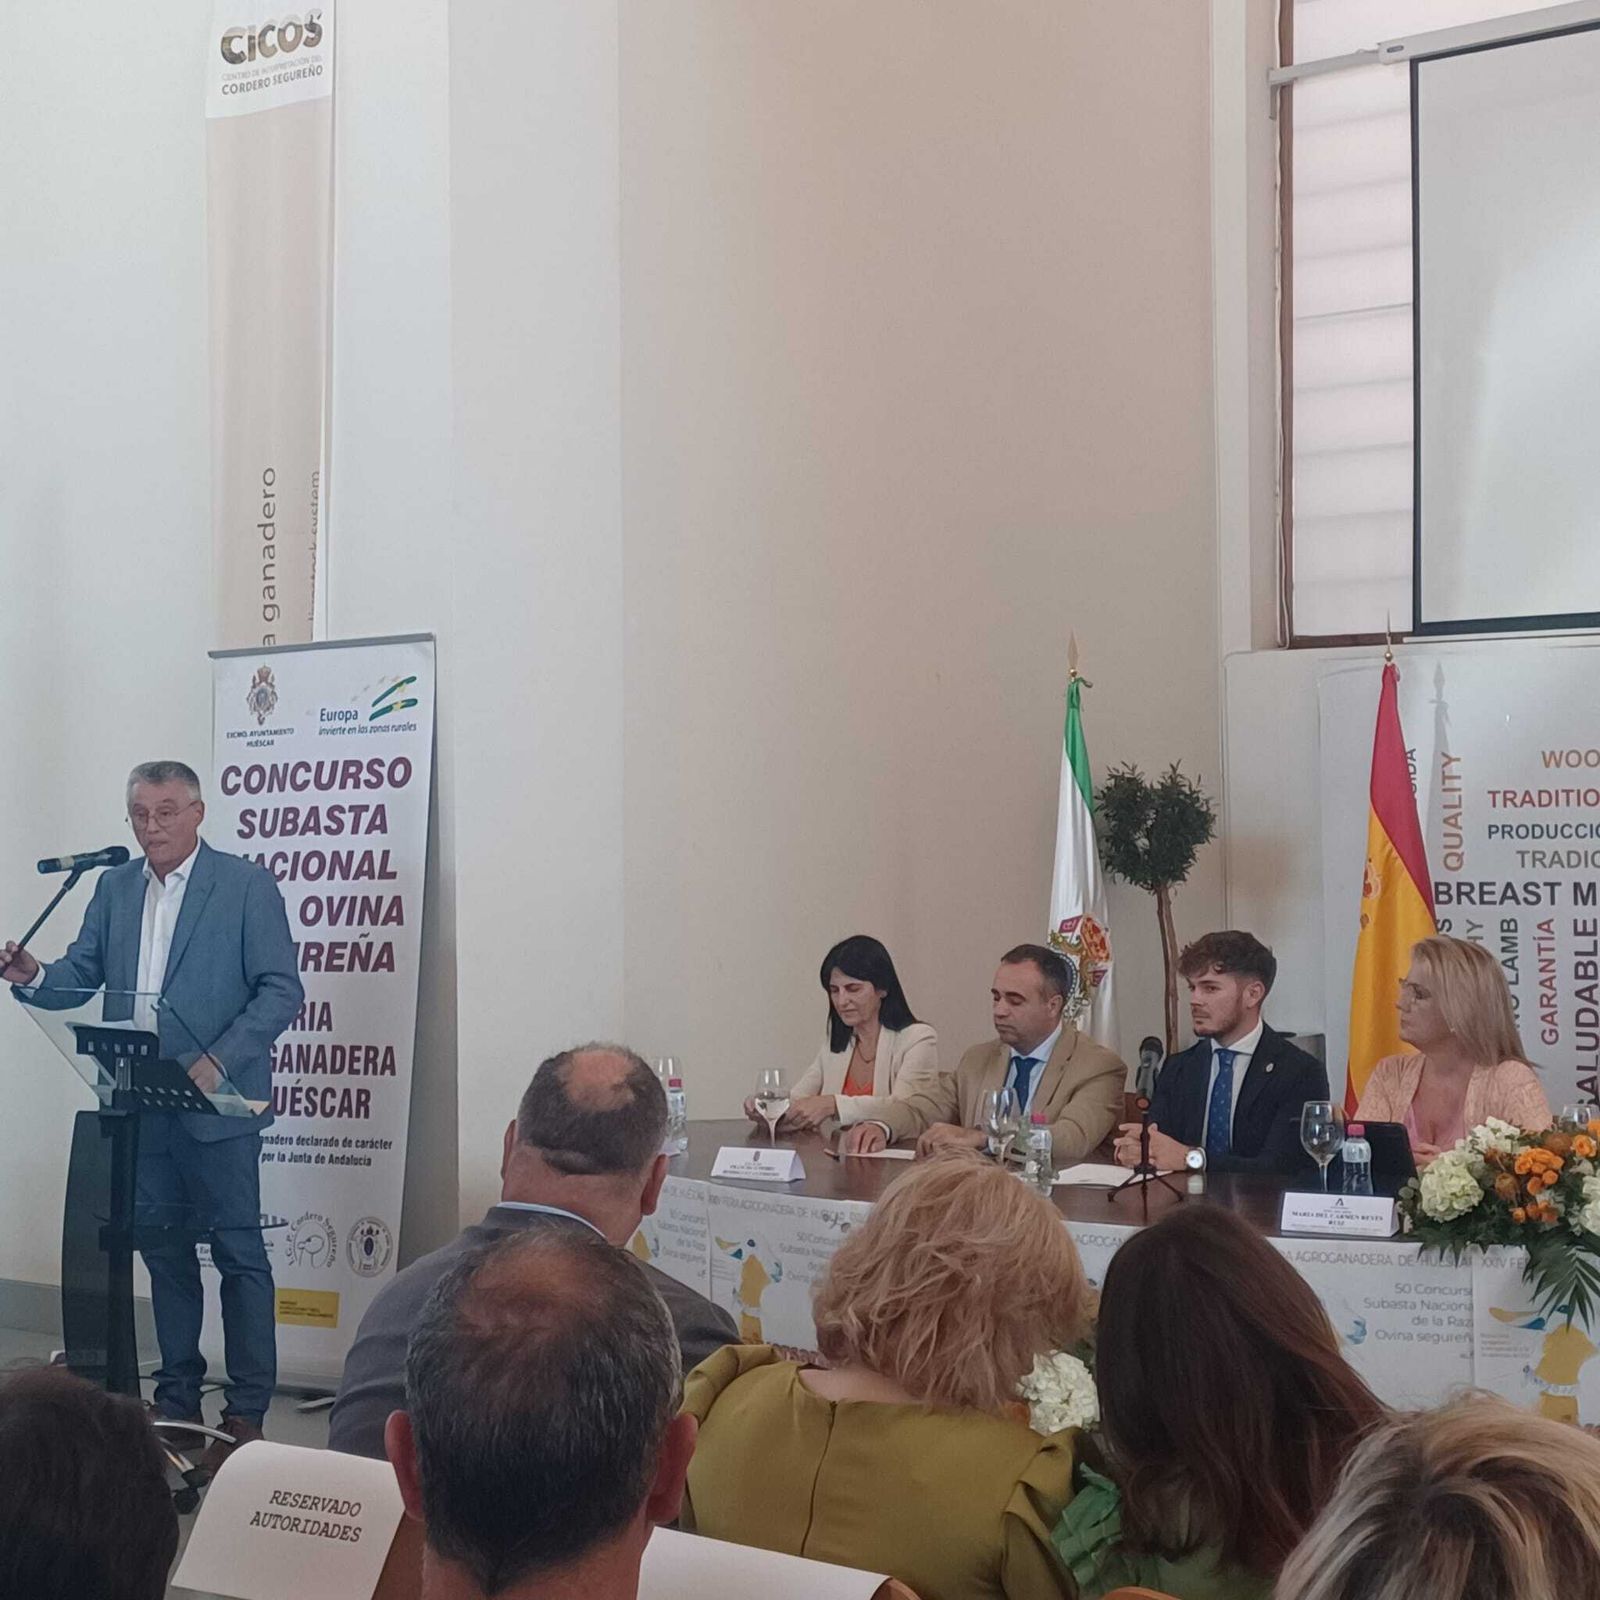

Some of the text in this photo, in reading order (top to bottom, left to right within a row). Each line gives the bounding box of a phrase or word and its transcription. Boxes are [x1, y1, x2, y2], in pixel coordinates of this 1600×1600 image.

[220, 12, 323, 65] CICOS
[221, 64, 323, 95] CORDERO SEGUREÑO
[257, 467, 281, 622] ganadero
[320, 708, 358, 723] Europa
[249, 727, 294, 738] AYUNTAMIENTO
[318, 725, 347, 736] invierte
[347, 727, 357, 735] en
[369, 724, 390, 734] zonas
[391, 721, 417, 733] rurales
[1541, 749, 1600, 768] WOO
[220, 756, 413, 796] CONCURSO
[1487, 788, 1600, 808] TRADITIO
[236, 804, 388, 839] SUBASTA
[1441, 752, 1465, 872] QUALITY
[243, 849, 397, 882] ACIONAL
[1434, 881, 1561, 906] BREAST
[299, 895, 404, 927] OVINA
[1532, 918, 1559, 1046] GARANTÍA
[295, 1135, 340, 1148] declarado
[342, 1137, 353, 1148] de
[261, 1153, 275, 1164] por
[277, 1152, 286, 1162] la
[288, 1152, 312, 1164] Junta
[314, 1153, 326, 1164] de
[1295, 1251, 1393, 1266] AGROGANADERA
[1398, 1254, 1414, 1267] DE
[1363, 1297, 1417, 1311] Subasta
[1411, 1315, 1428, 1327] de
[1431, 1314, 1443, 1327] la
[1375, 1328, 1414, 1342] Ovina
[269, 1489, 362, 1518] RESERVADO
[250, 1510, 362, 1543] AUTORIDADES
